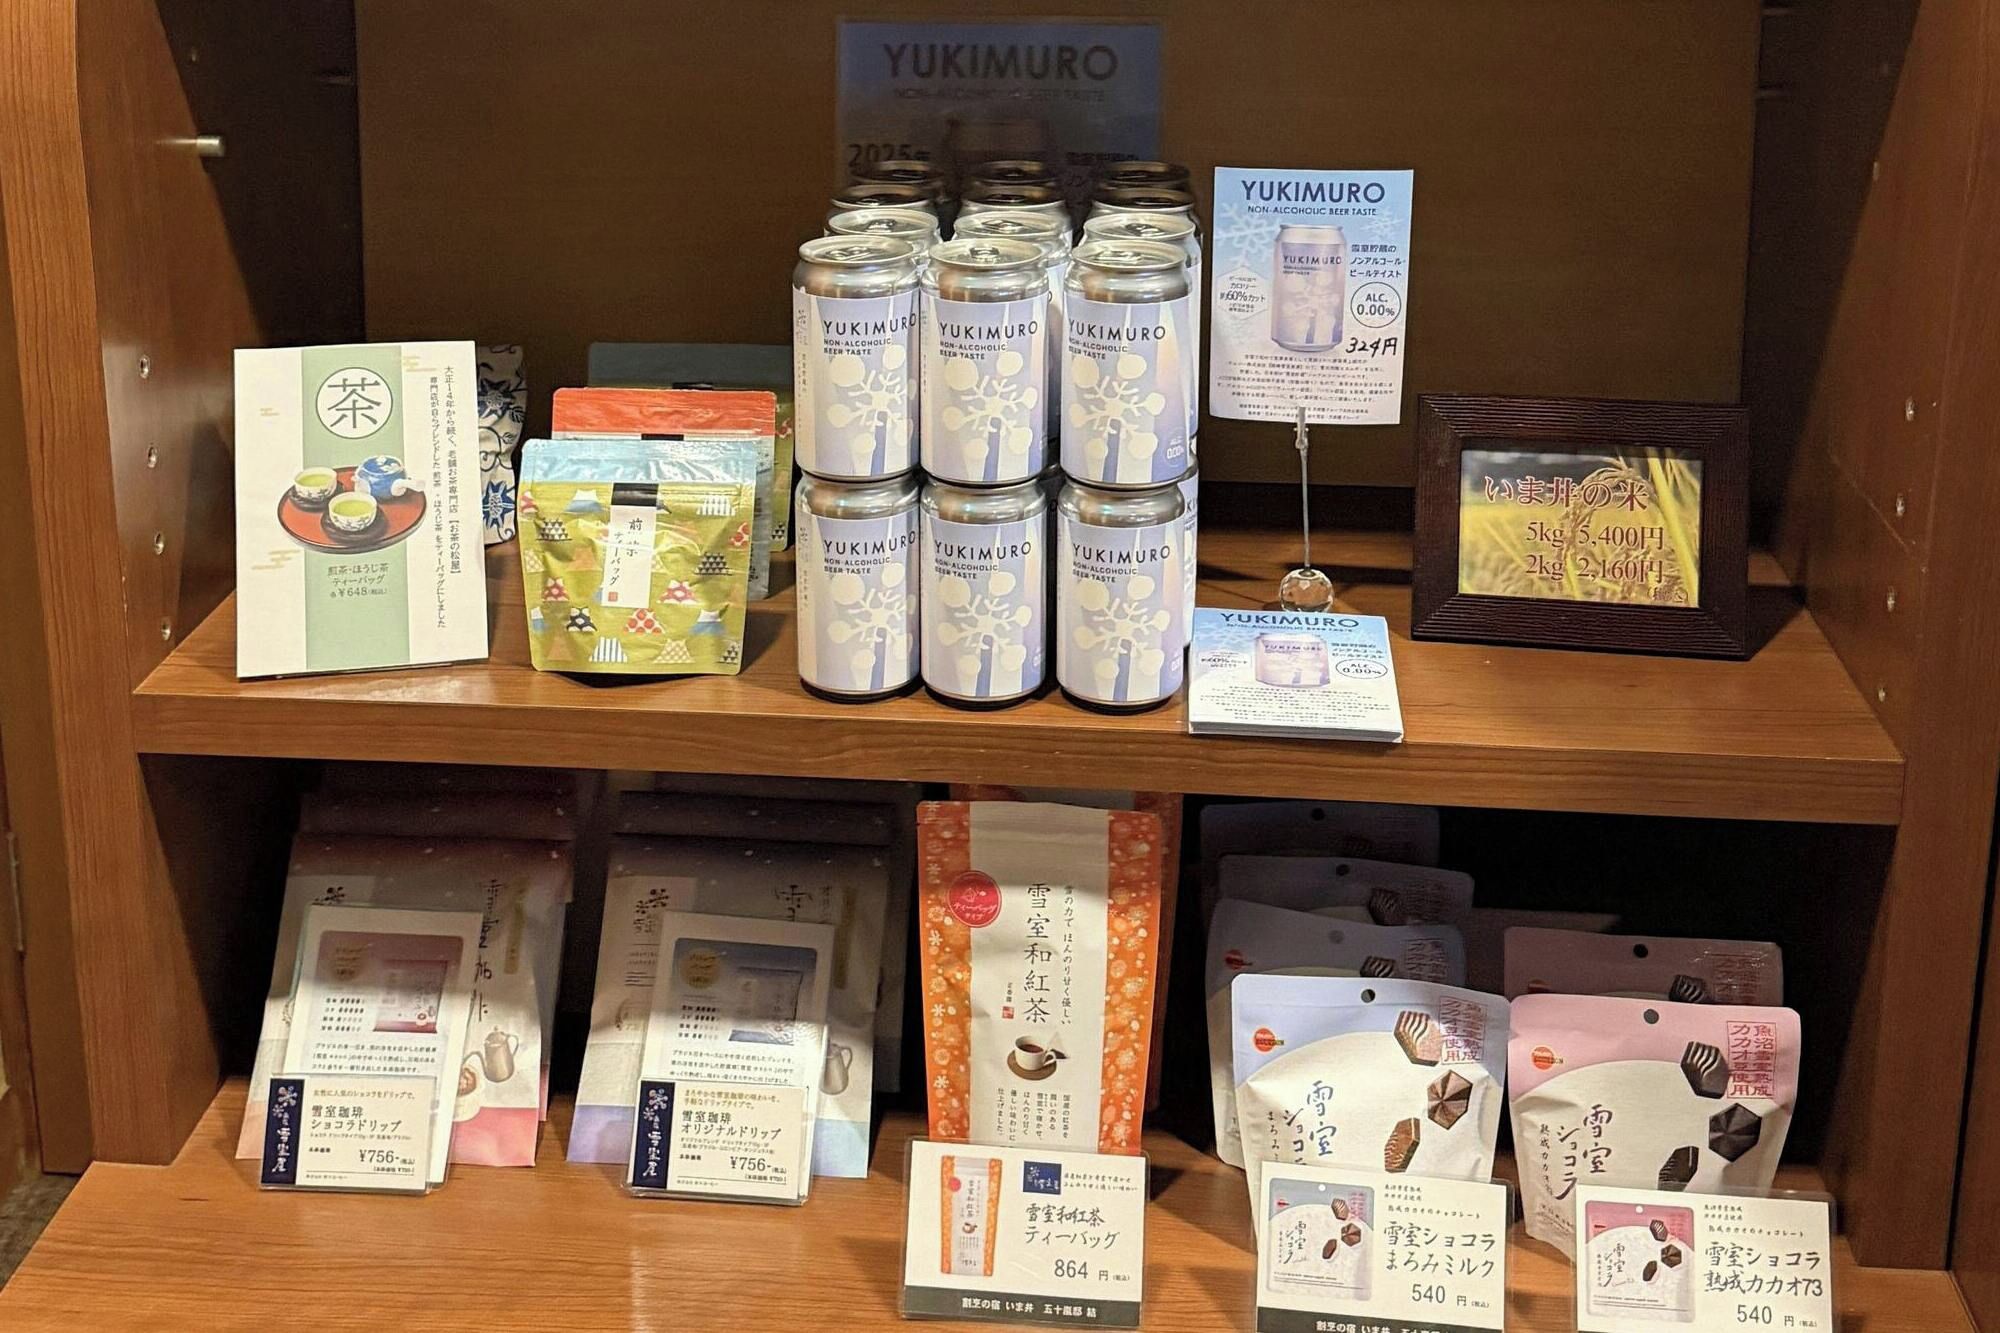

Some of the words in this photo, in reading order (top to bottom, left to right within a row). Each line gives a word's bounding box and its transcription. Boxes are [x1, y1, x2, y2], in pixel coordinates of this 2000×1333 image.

[884, 42, 1119, 82] YUKIMURO
[1242, 180, 1386, 204] YUKIMURO
[1248, 206, 1326, 216] NON-ALCOHOLIC
[1329, 208, 1350, 216] BEER
[1352, 208, 1377, 216] TASTE
[1283, 254, 1343, 265] YUKIMURO
[1349, 269, 1402, 279] ビールテイスト
[1365, 293, 1388, 303] ALC.
[1356, 303, 1395, 317] 0.00%
[823, 313, 917, 336] YUKIMURO
[940, 320, 1038, 341] YUKIMURO
[1068, 318, 1166, 342] YUKIMURO
[823, 338, 892, 348] NON-ALCOHOLIC
[846, 348, 872, 356] TASTE
[1345, 337, 1398, 358] 324円
[960, 351, 985, 360] TASTE
[1083, 350, 1106, 360] TASTE
[327, 377, 382, 429] 茶
[1484, 475, 1648, 513] いま井の米
[823, 530, 916, 556] YUKIMURO
[1526, 521, 1565, 548] 5kg
[1577, 524, 1665, 551] 5,400円
[934, 540, 1032, 561] YUKIMURO
[1072, 543, 1171, 565] YUKIMURO
[846, 567, 872, 575] TASTE
[953, 571, 978, 580] TASTE
[1091, 573, 1117, 584] TASTE
[1525, 553, 1564, 582] 2kg
[1576, 556, 1664, 585] 2,160円
[1221, 612, 1360, 628] YUKIMURO
[1023, 882, 1053, 1024] 雪室和紅茶
[1730, 1024, 1752, 1096] カカオ豆使用
[1751, 1024, 1774, 1096] 魚沼雪室熟成
[311, 1104, 364, 1119] 雪室珈琲
[681, 1110, 732, 1124] 雪室珈琲
[1307, 1080, 1337, 1156] 雪室
[311, 1118, 402, 1133] ショコラドリップ
[681, 1123, 782, 1140] オリジナルドリップ
[1582, 1104, 1613, 1173] 雪室
[1557, 1125, 1580, 1200] ショコラ
[1025, 1203, 1106, 1227] 雪室和紅茶
[1024, 1226, 1120, 1250] ティーバッグ
[1383, 1221, 1496, 1252] 雪室ショコラ
[1384, 1249, 1496, 1278] まろみミルク
[1705, 1242, 1821, 1270] 雪室ショコラ
[1053, 1259, 1089, 1279] 864
[1098, 1270, 1109, 1281] 円
[1411, 1283, 1446, 1304] 540
[1456, 1295, 1467, 1306] 円
[1704, 1270, 1823, 1297] 熟成カカオ73
[961, 1297, 1001, 1310] 割烹の宿
[1005, 1301, 1035, 1313] いま井
[1736, 1304, 1772, 1325] 540
[1784, 1315, 1795, 1327] 円
